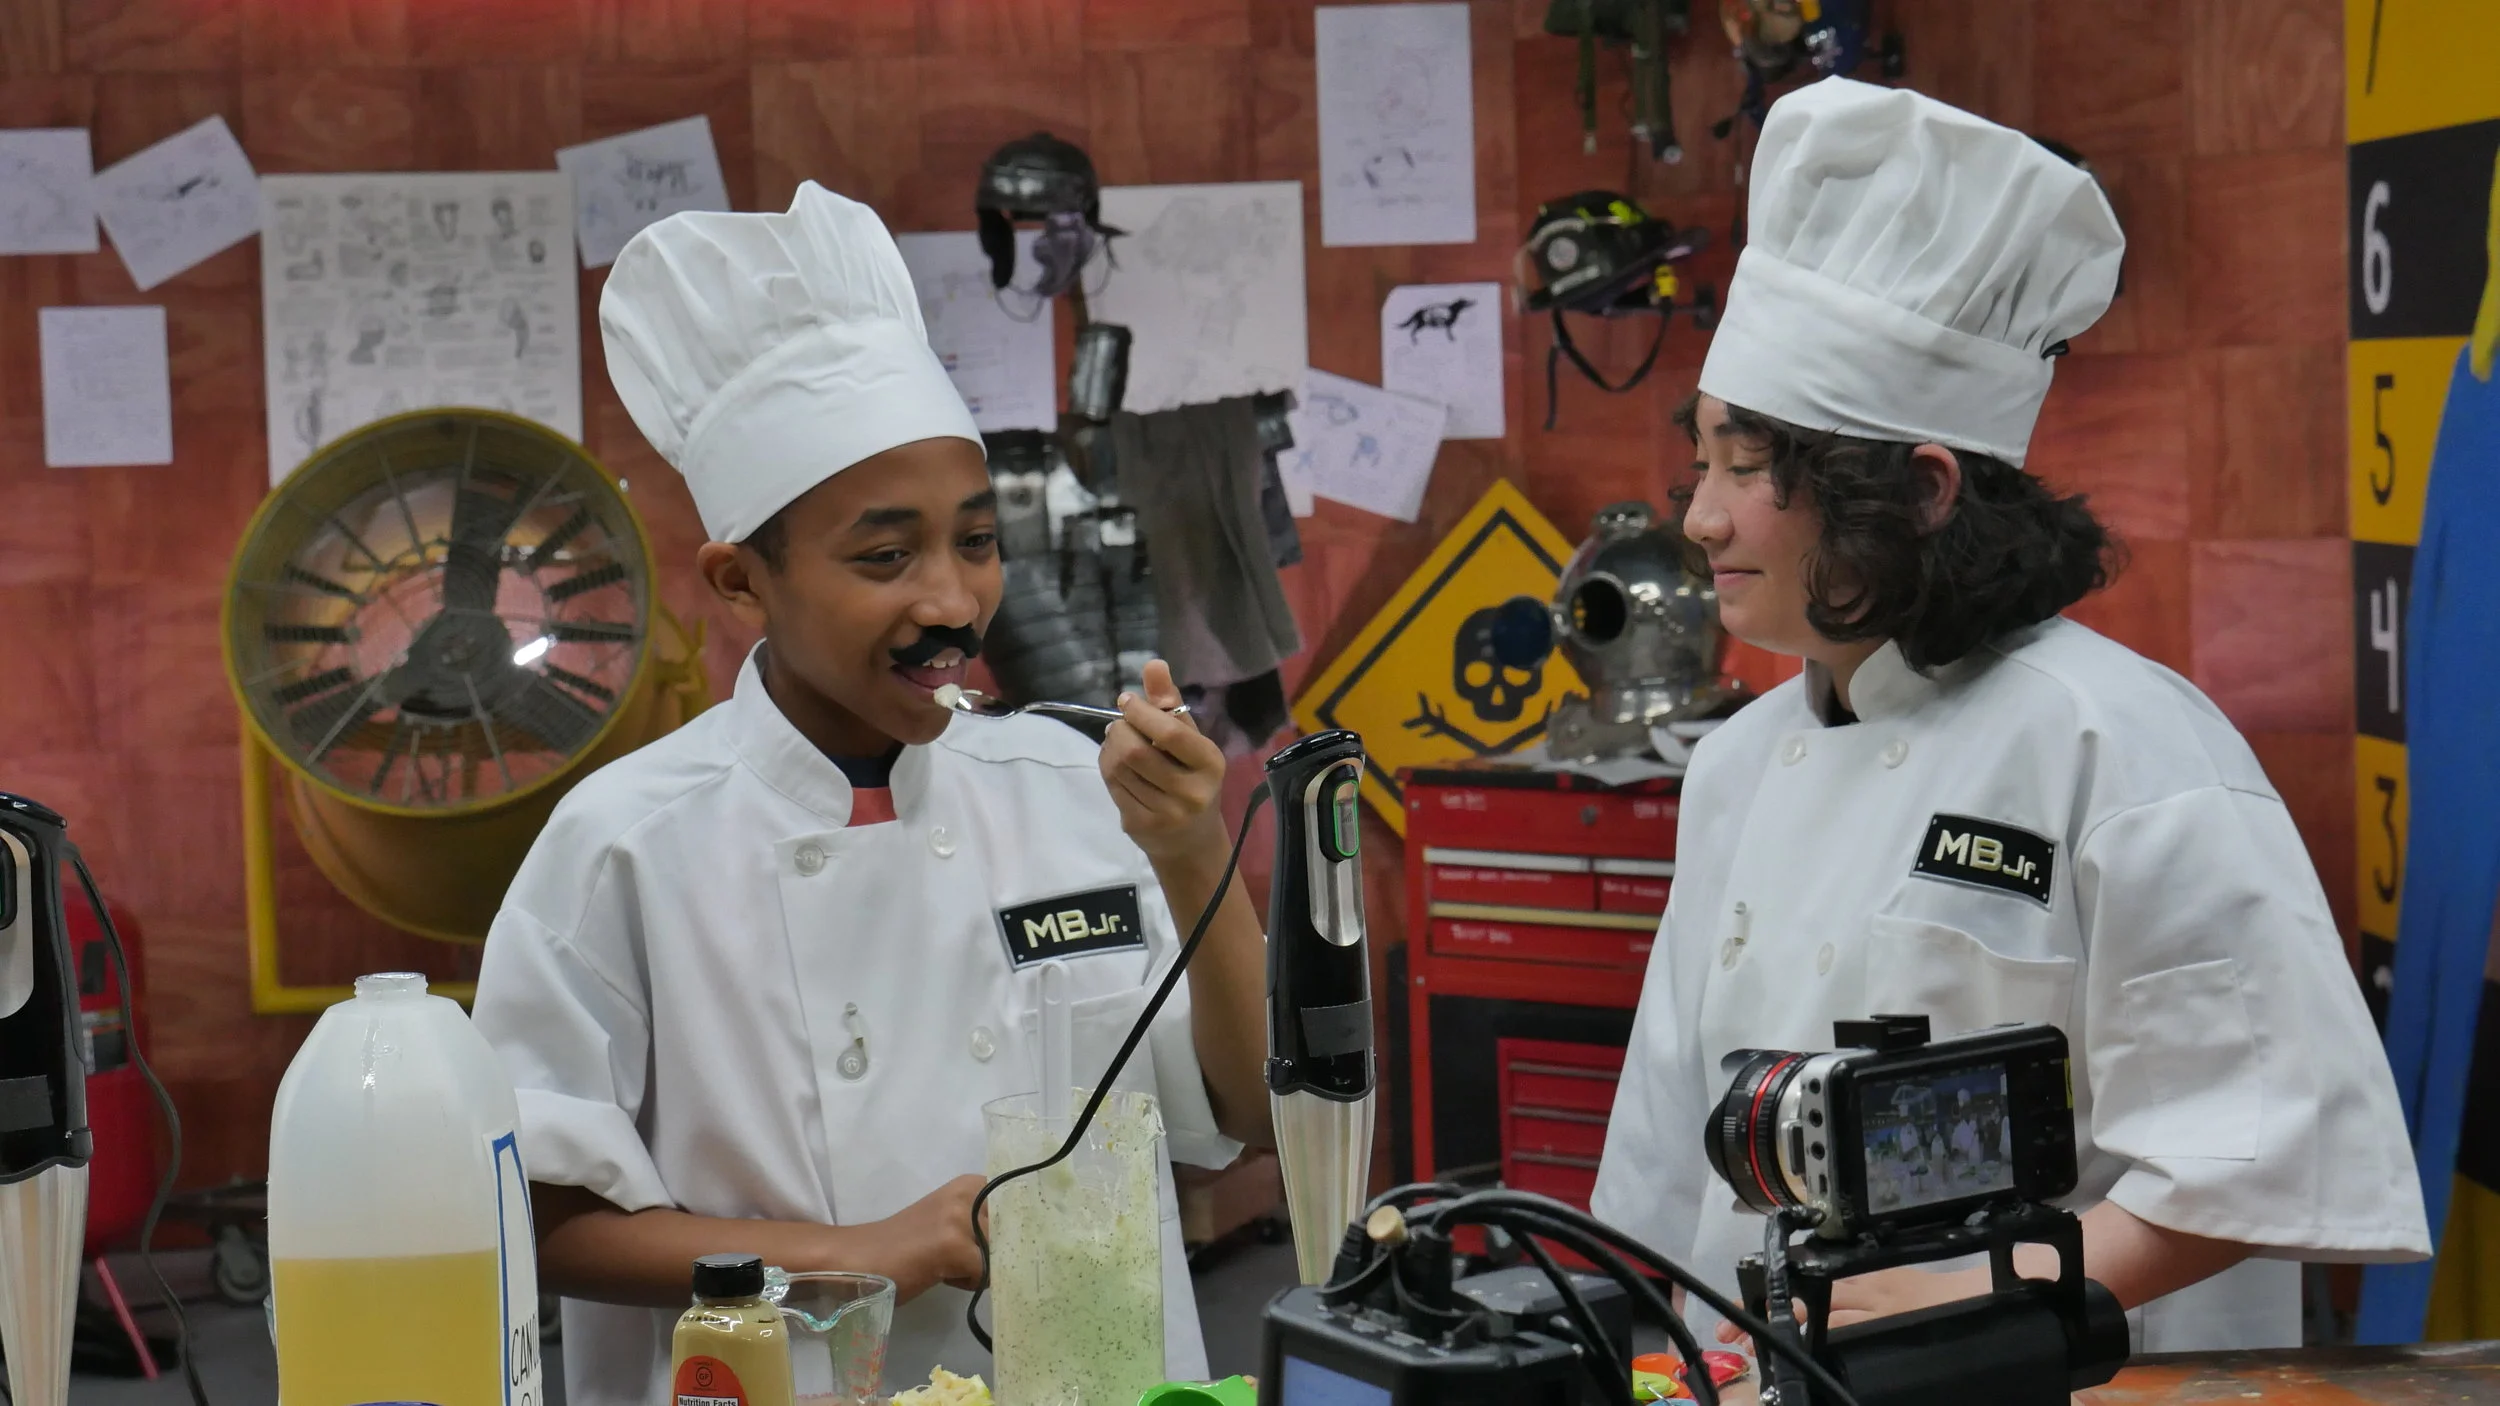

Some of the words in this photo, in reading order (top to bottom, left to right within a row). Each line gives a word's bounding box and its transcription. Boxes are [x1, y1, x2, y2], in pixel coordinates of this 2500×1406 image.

[2363, 180, 2392, 315] 6
[2370, 373, 2395, 506] 5
[2370, 576, 2399, 714] 4
[2373, 775, 2398, 904] 3
[679, 1397, 710, 1406] Nutrition
